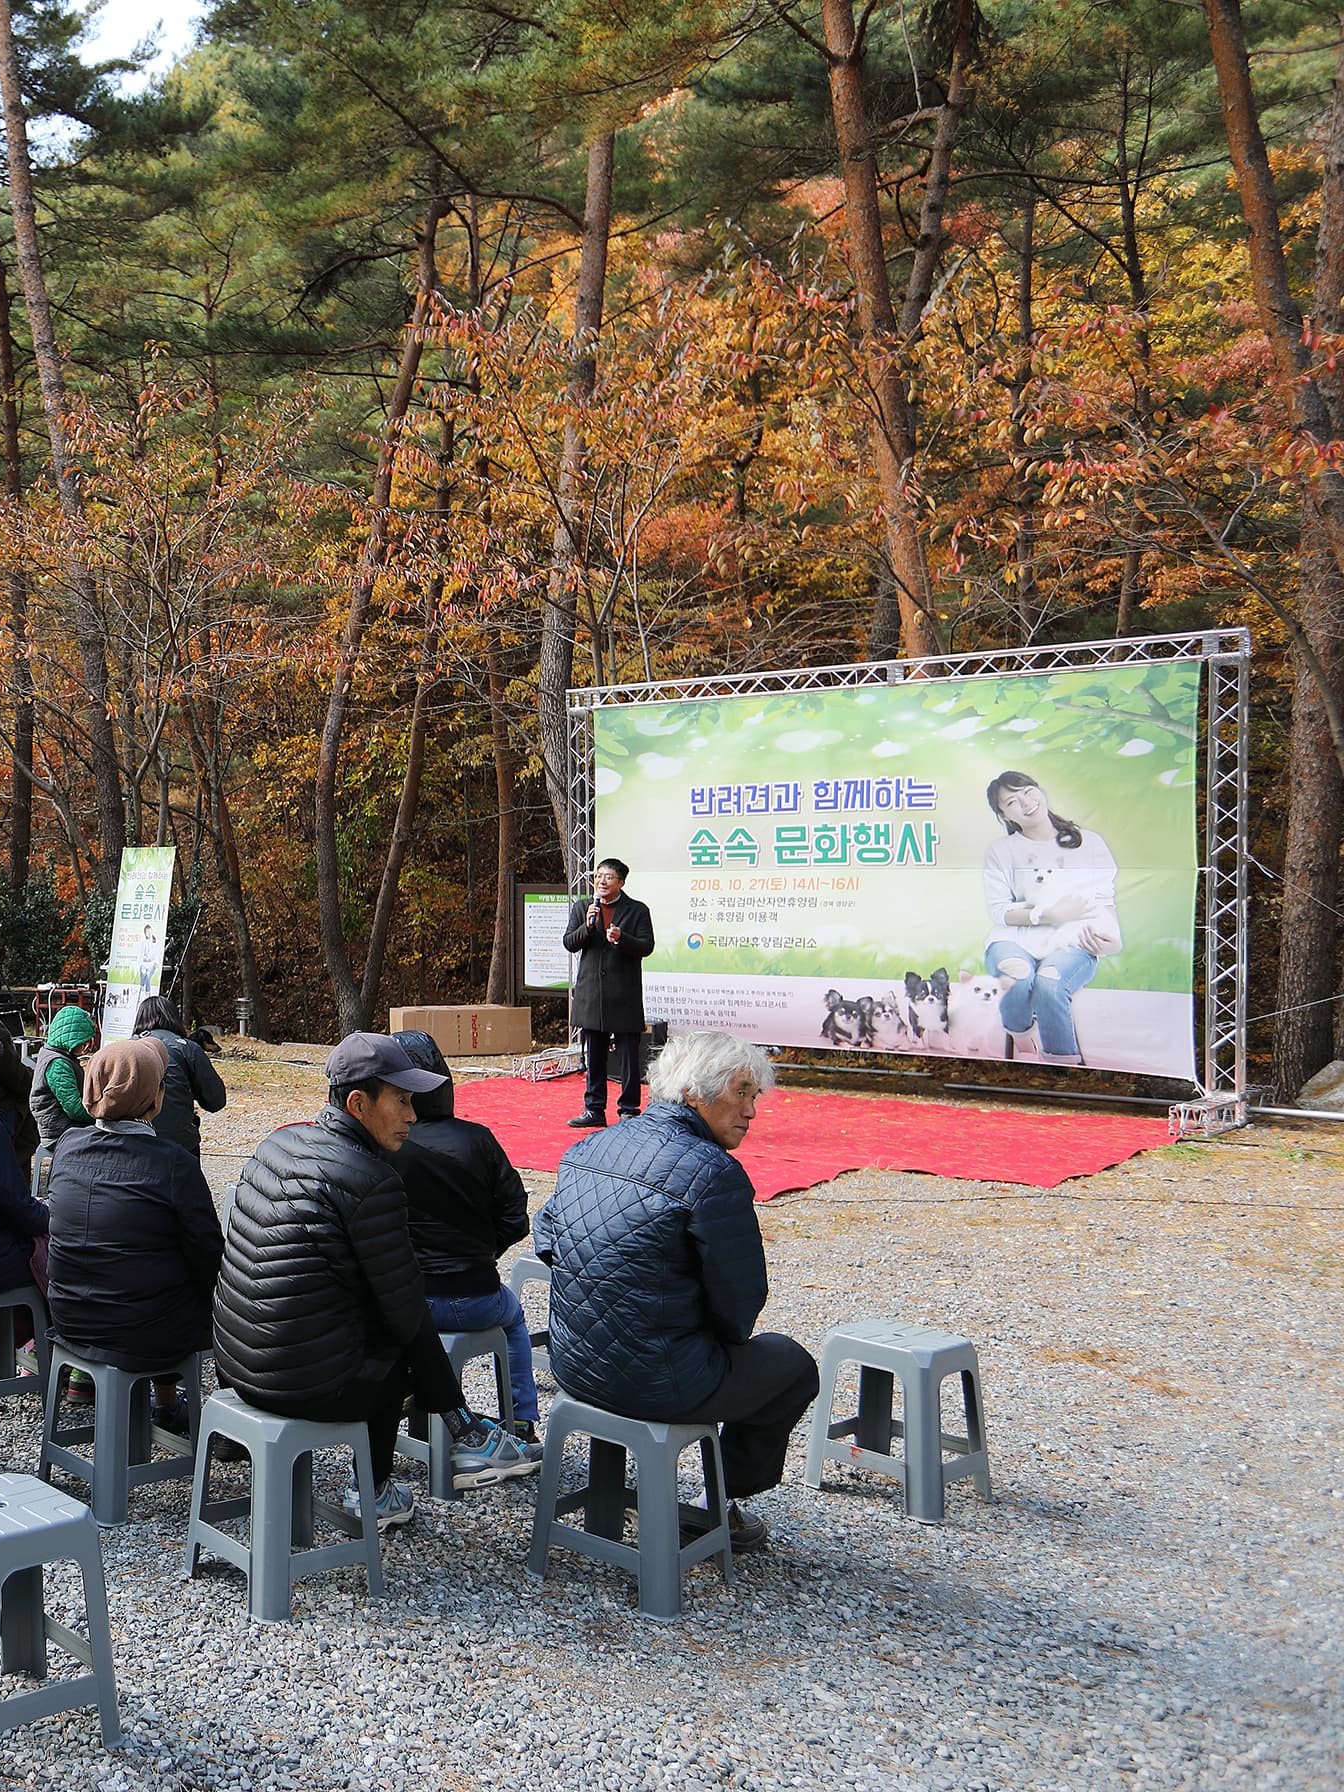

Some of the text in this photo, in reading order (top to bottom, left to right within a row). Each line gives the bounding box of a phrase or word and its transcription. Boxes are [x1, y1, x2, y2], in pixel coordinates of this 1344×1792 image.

[690, 777, 937, 816] 반려견과 함께하는
[688, 821, 940, 867] 숲속 문화행사
[134, 883, 156, 900] 숲속
[690, 877, 860, 891] 2018. 10. 27(토) 14시~16시
[689, 896, 708, 908] 장소
[717, 896, 818, 908] 국립검마산자연휴양림
[121, 903, 165, 920] 문화행사
[688, 911, 706, 922] 대상
[716, 911, 745, 922] 휴양림
[748, 911, 778, 923] 이용객
[707, 935, 817, 949] 국립자연휴양림관리소
